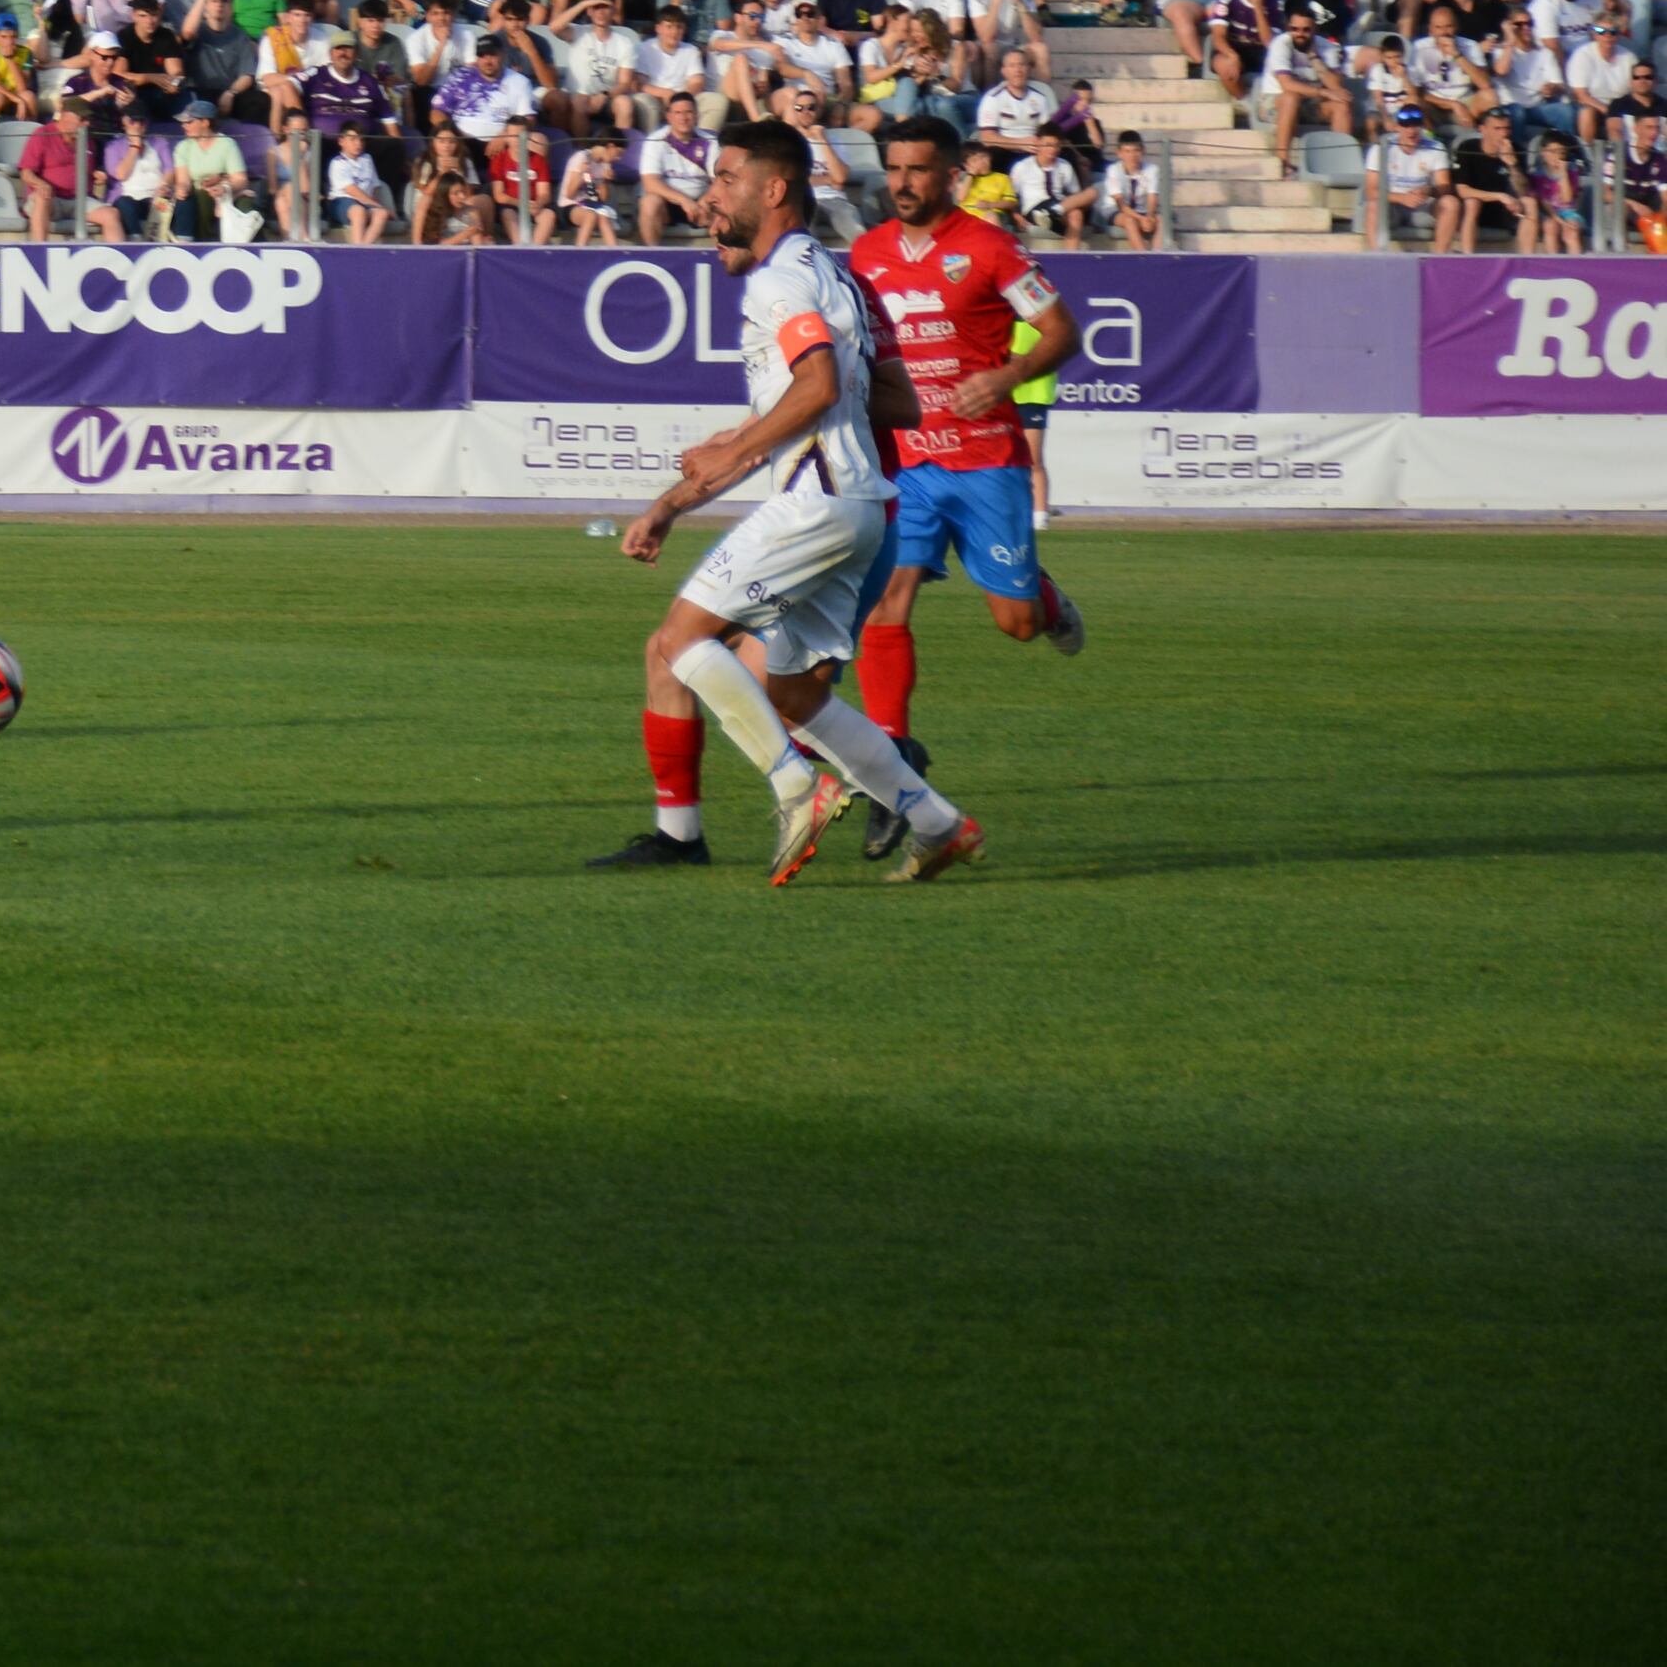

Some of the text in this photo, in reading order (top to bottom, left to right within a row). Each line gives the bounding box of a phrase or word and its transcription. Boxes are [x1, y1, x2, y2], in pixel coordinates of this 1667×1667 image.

[918, 319, 959, 337] CHECA
[173, 424, 220, 438] GRUPO
[134, 425, 333, 472] Avanza
